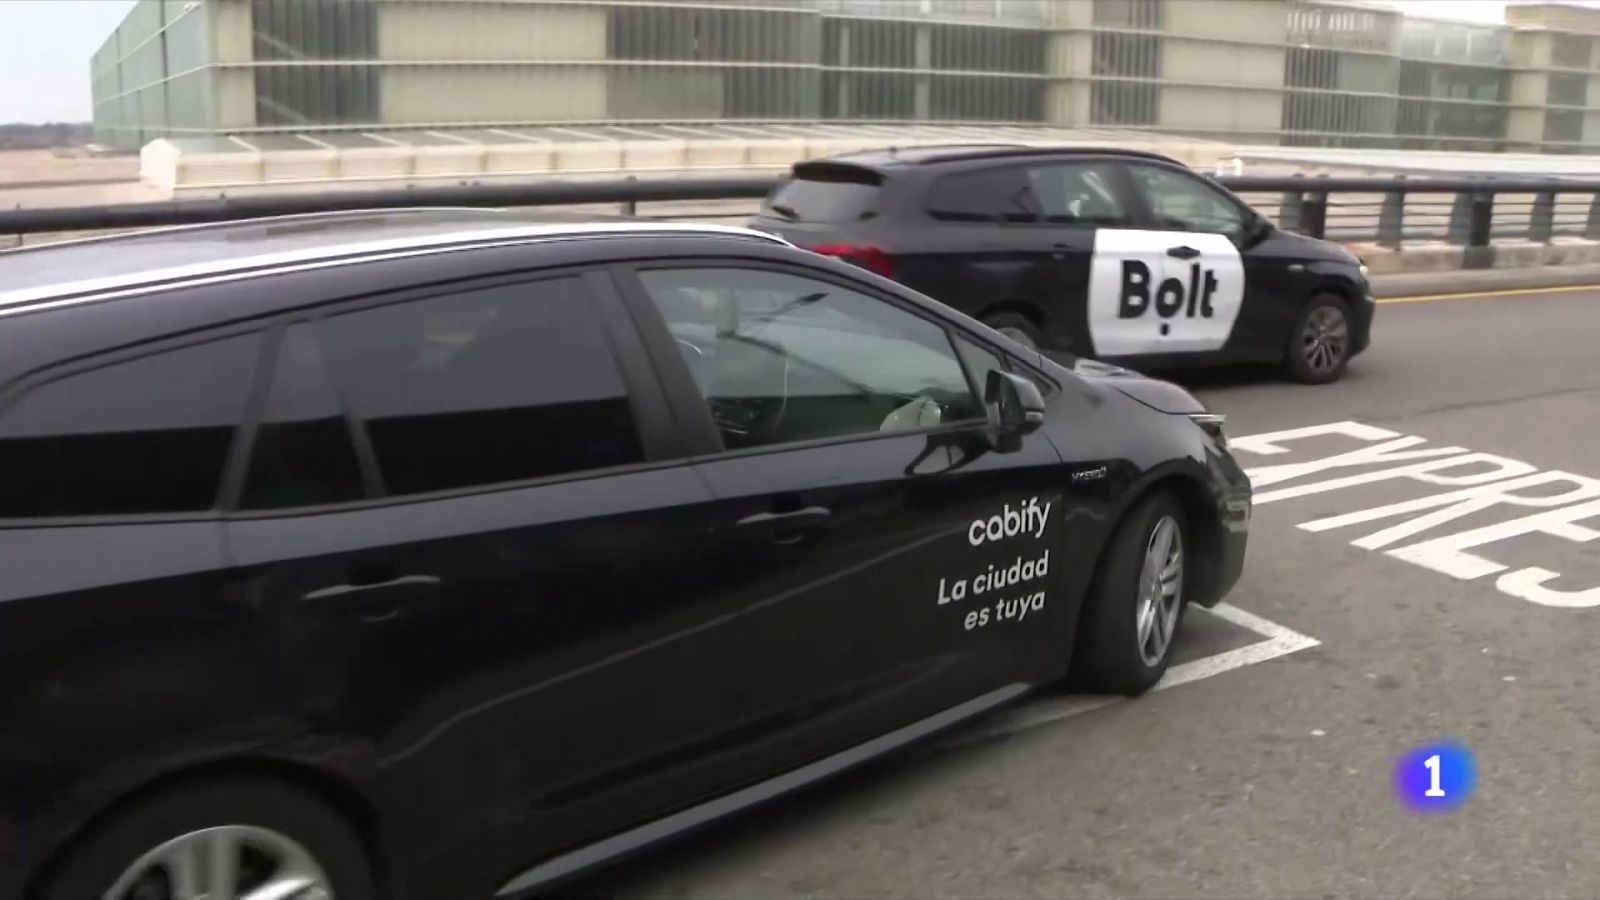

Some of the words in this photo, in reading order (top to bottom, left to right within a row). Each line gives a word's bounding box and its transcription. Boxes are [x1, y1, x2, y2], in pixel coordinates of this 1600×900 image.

[1117, 259, 1218, 319] Bolt
[968, 497, 1051, 546] cabify
[937, 578, 967, 605] La
[972, 549, 1049, 594] ciudad
[964, 607, 989, 631] es
[995, 591, 1046, 622] tuya
